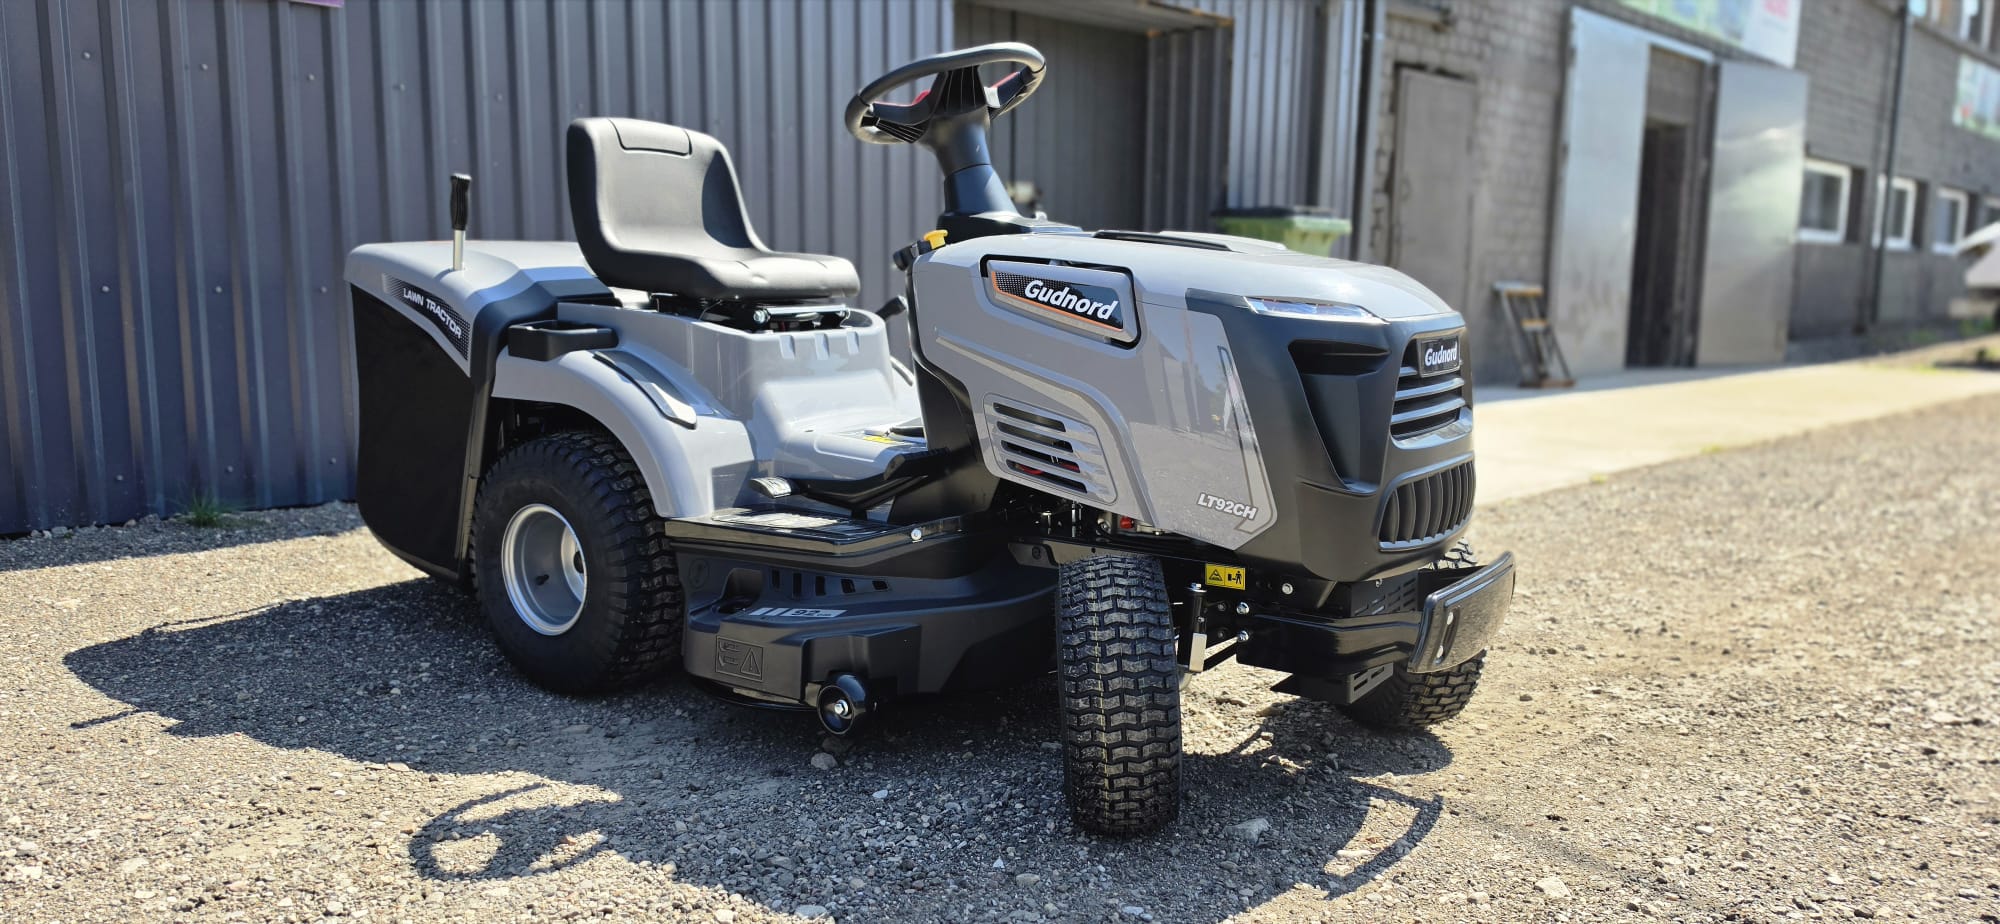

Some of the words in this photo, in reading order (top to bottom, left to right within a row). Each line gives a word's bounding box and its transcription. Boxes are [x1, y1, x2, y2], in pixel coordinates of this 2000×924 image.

[403, 288, 424, 306] LAWN
[426, 298, 462, 339] TRACTOR
[1024, 279, 1118, 320] Gudnord
[1424, 340, 1458, 367] Gudnord
[1197, 493, 1257, 520] LT92CH
